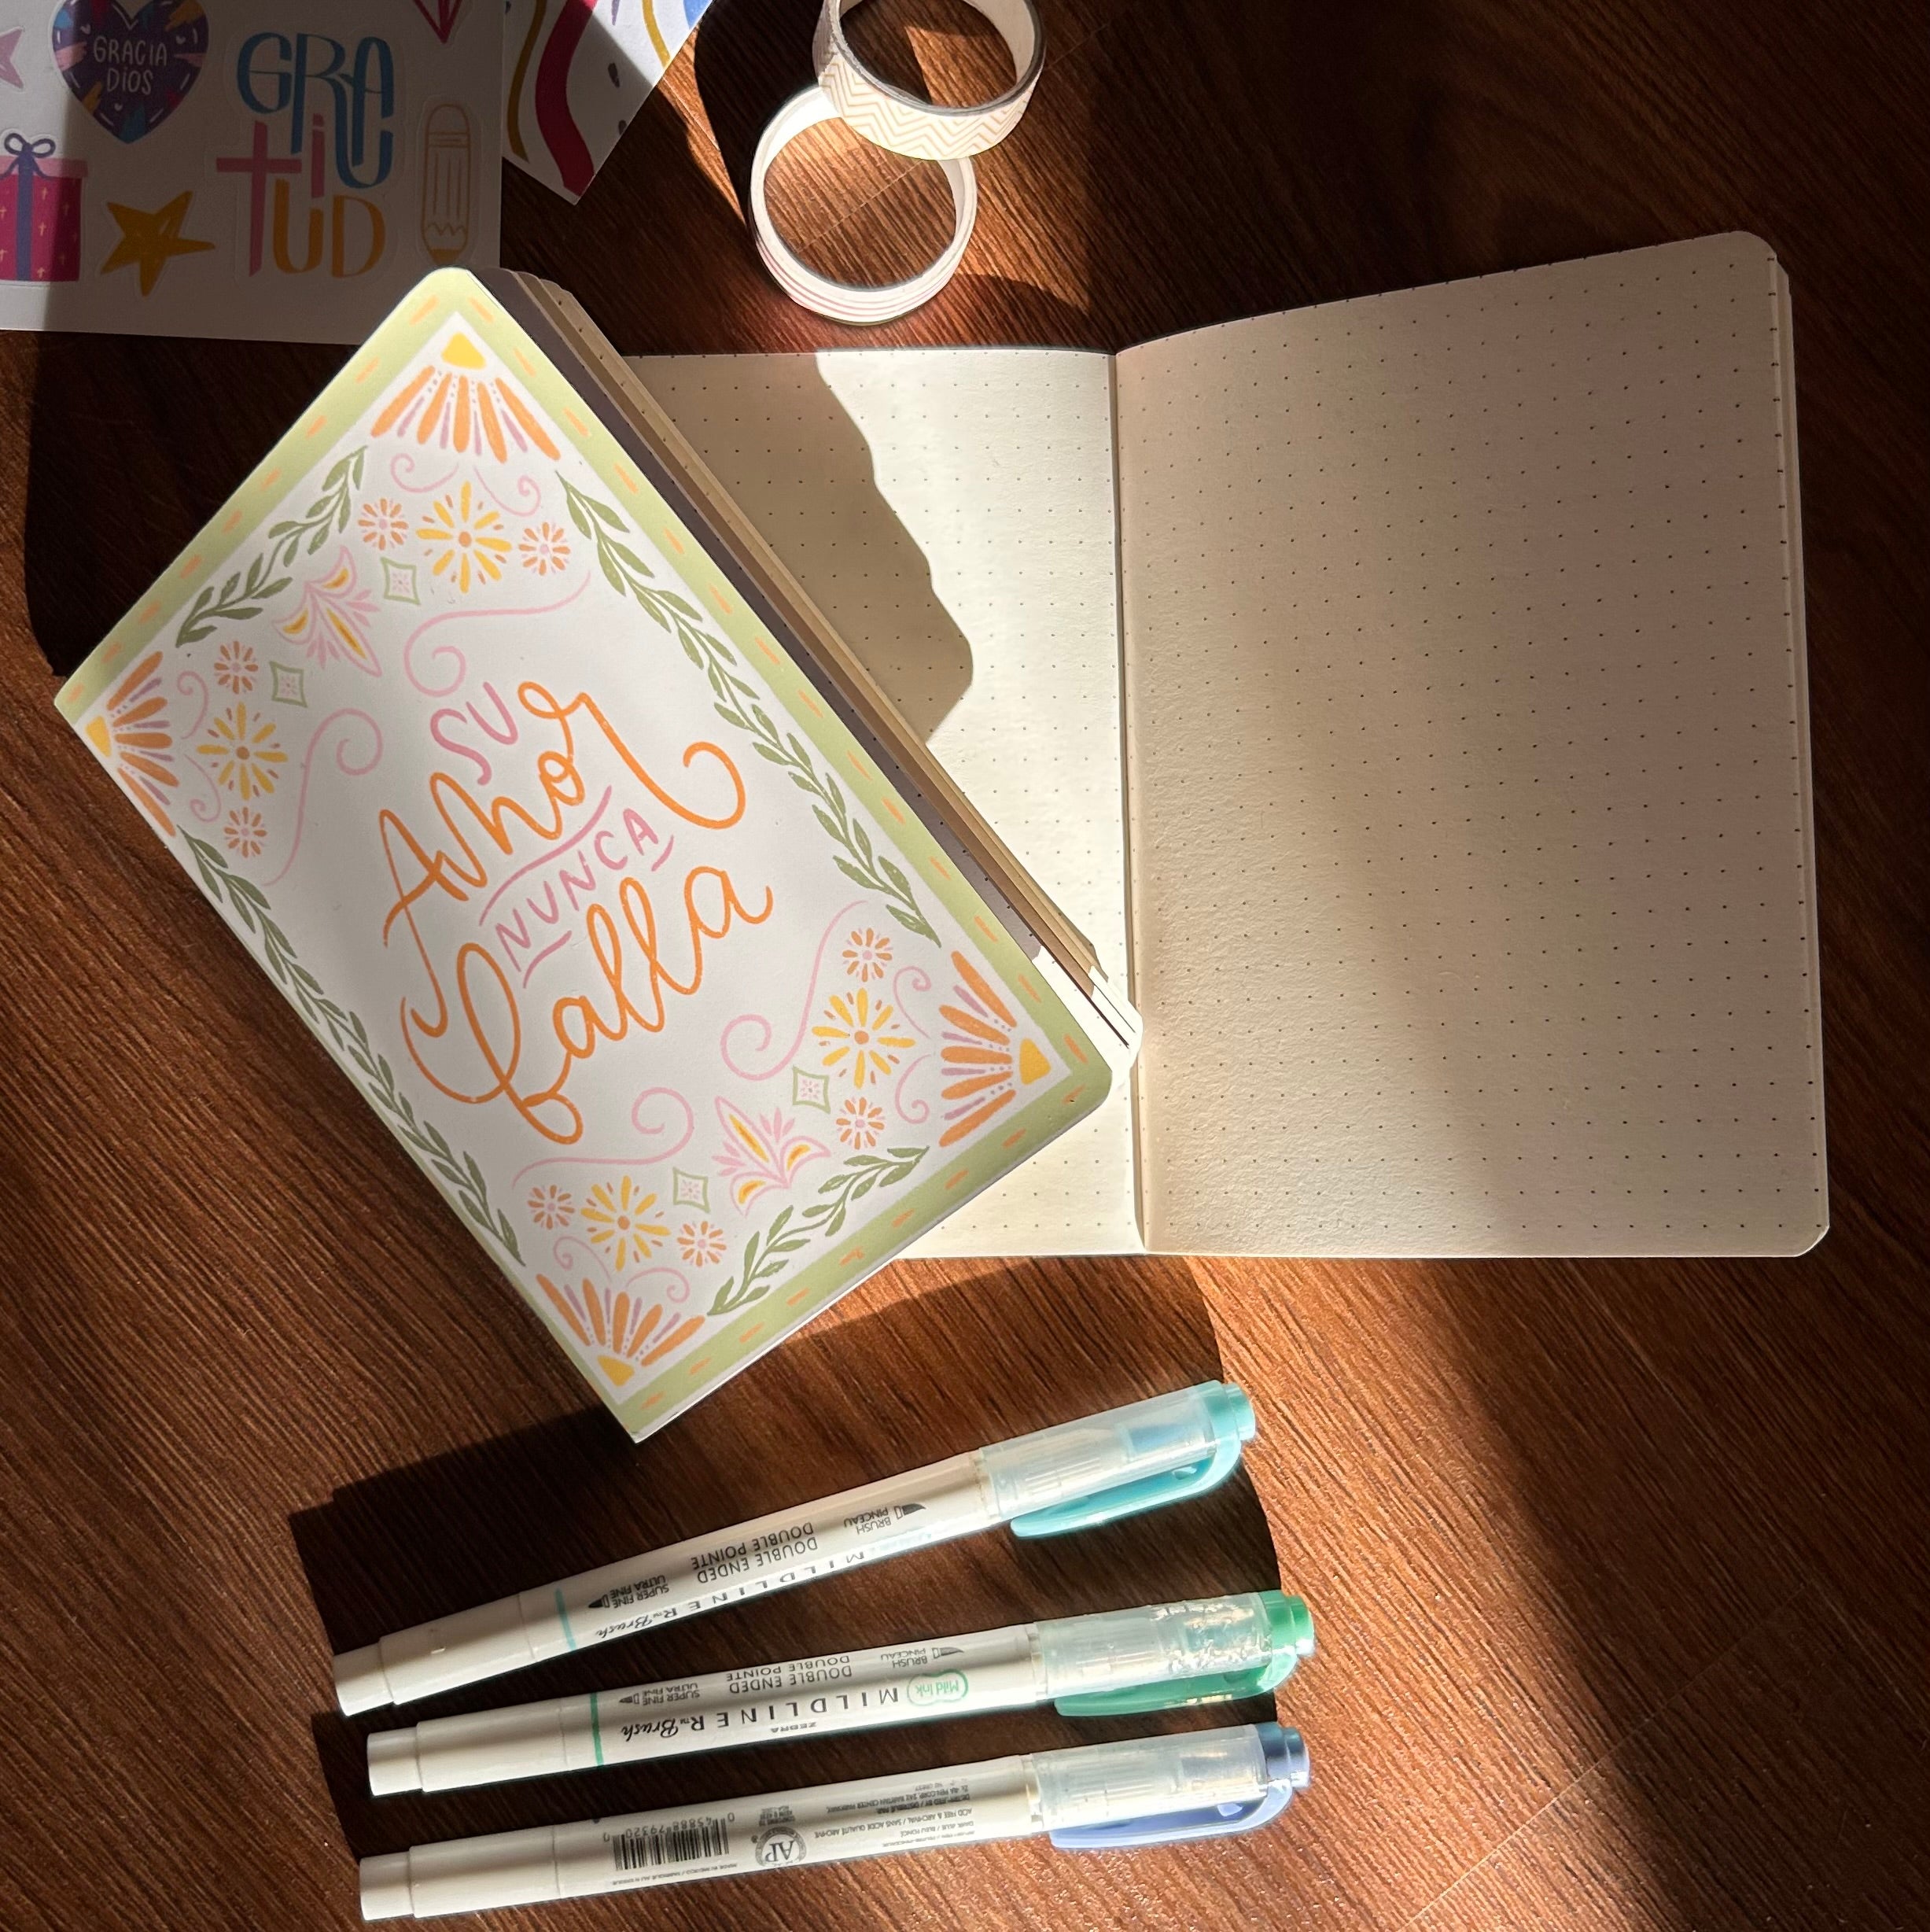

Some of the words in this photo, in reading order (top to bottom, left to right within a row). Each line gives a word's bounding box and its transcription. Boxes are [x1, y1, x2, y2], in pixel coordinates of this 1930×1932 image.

[93, 35, 168, 67] GRACIA
[429, 680, 519, 786] SU
[495, 808, 659, 972] NUNCA
[844, 1507, 889, 1528] PINCEAU
[856, 1517, 891, 1535] BRUSH
[753, 1522, 814, 1551] DOUBLE
[691, 1543, 747, 1570] POINTE
[757, 1536, 818, 1567] DOUBLE
[697, 1557, 750, 1584] ENDED
[635, 1574, 666, 1591] ULTRA
[610, 1585, 632, 1600] FINE
[637, 1584, 669, 1601] SUPER
[612, 1595, 635, 1609] FINE
[789, 1655, 850, 1672] DOUBLE
[892, 1655, 928, 1668] BRUSH
[727, 1666, 782, 1681] POINTE
[790, 1665, 852, 1686] DOUBLE
[729, 1676, 783, 1694] ENDED
[915, 1682, 934, 1698] Ink
[935, 1679, 959, 1696] Mild
[642, 1695, 664, 1706] FINE
[667, 1690, 700, 1702] SUPER
[621, 1718, 679, 1742] Brush
[764, 1840, 795, 1863] AP
